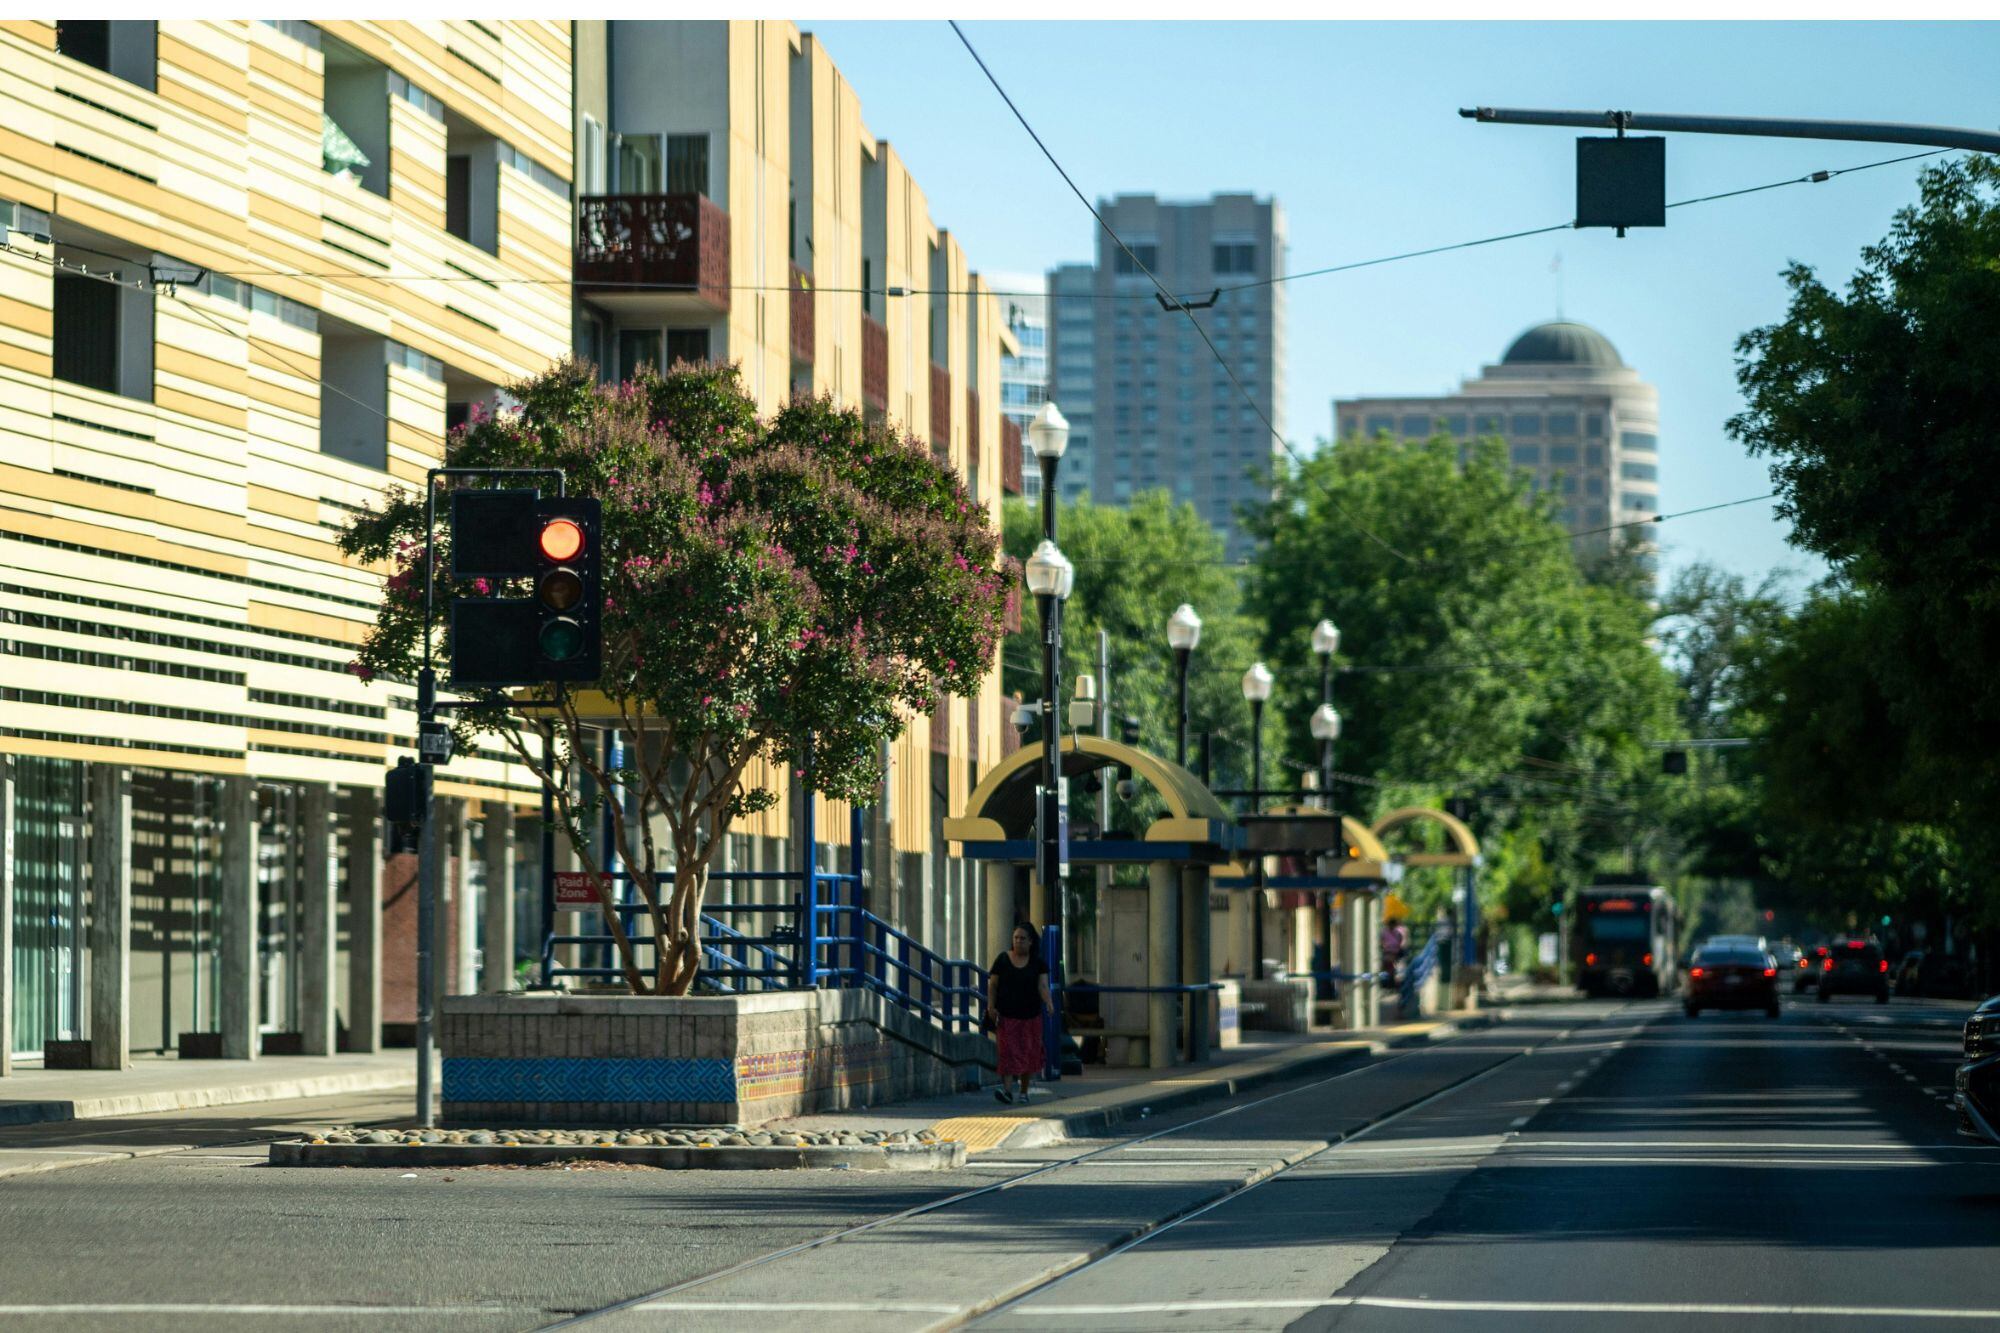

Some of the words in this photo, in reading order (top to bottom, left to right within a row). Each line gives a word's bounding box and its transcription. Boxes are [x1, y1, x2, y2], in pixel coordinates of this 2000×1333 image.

[559, 877, 583, 887] Paid
[586, 877, 611, 887] Fe
[560, 888, 588, 897] Zone
